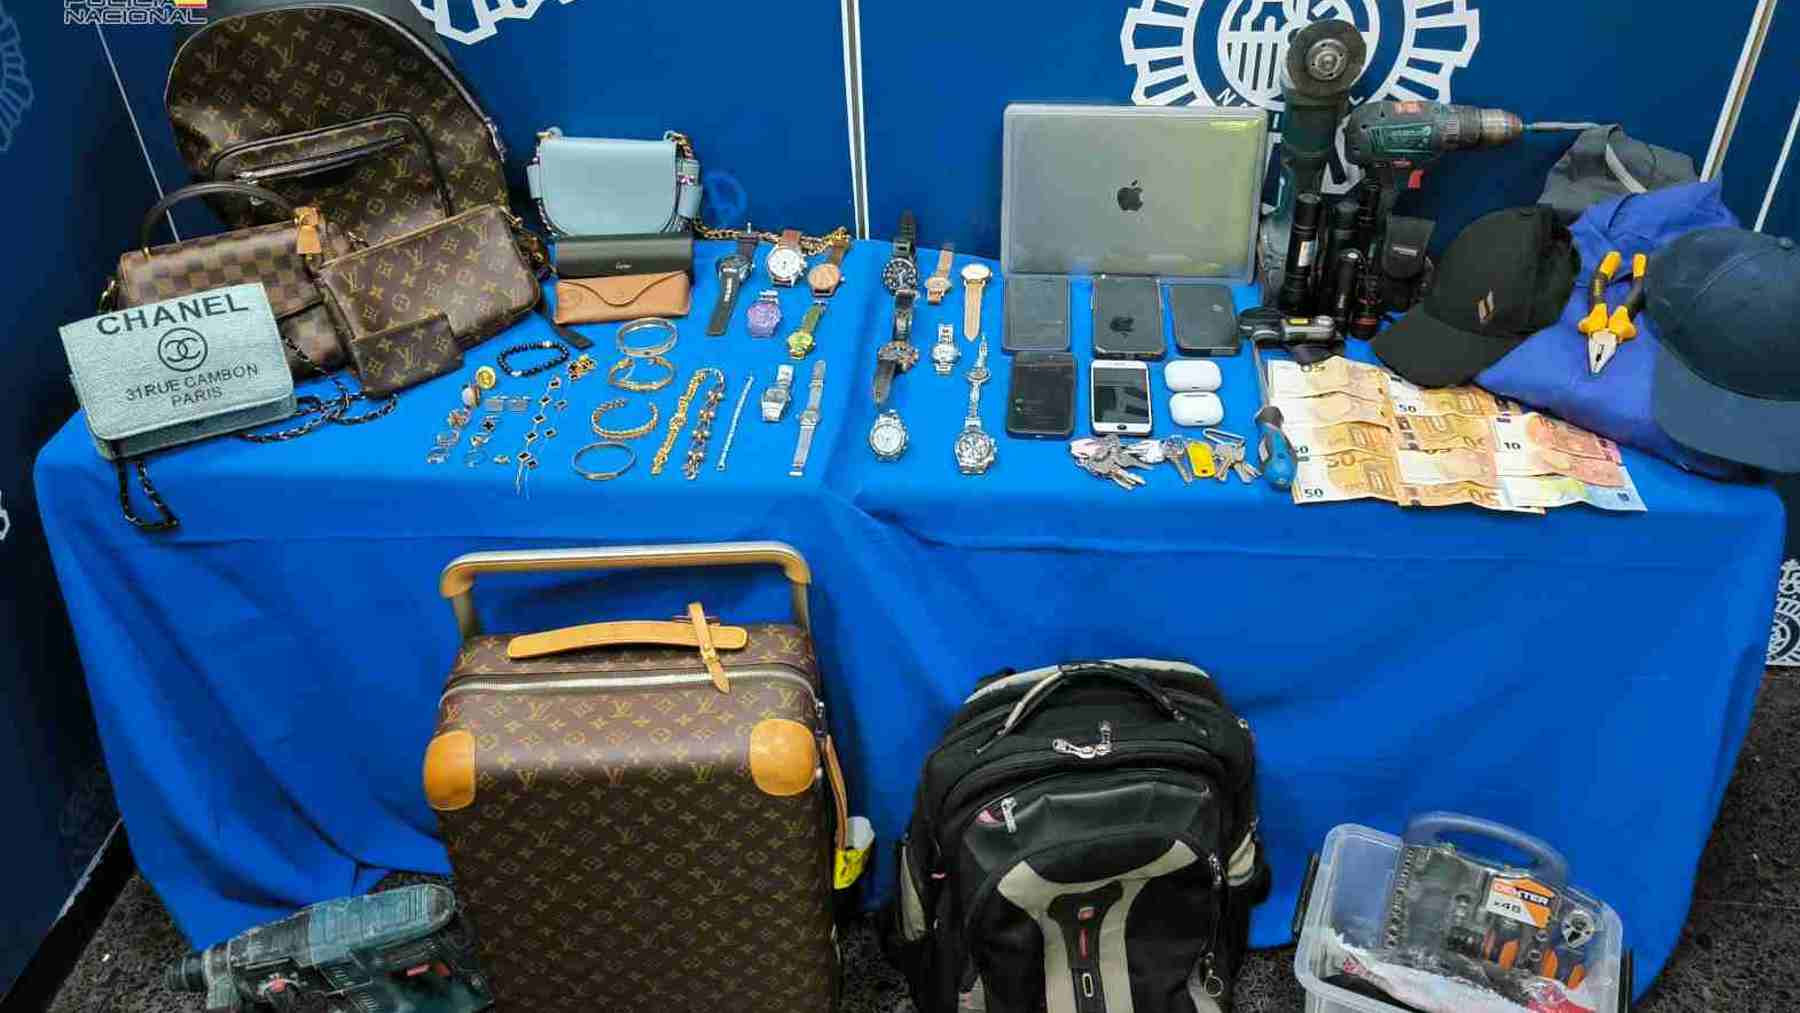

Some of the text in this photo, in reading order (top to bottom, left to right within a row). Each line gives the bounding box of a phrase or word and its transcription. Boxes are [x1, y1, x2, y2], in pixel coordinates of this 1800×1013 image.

[96, 293, 249, 335] CHANEL
[184, 364, 258, 389] CAMBON
[170, 386, 223, 407] PARIS
[1503, 441, 1521, 451] 10
[1304, 487, 1325, 499] 50
